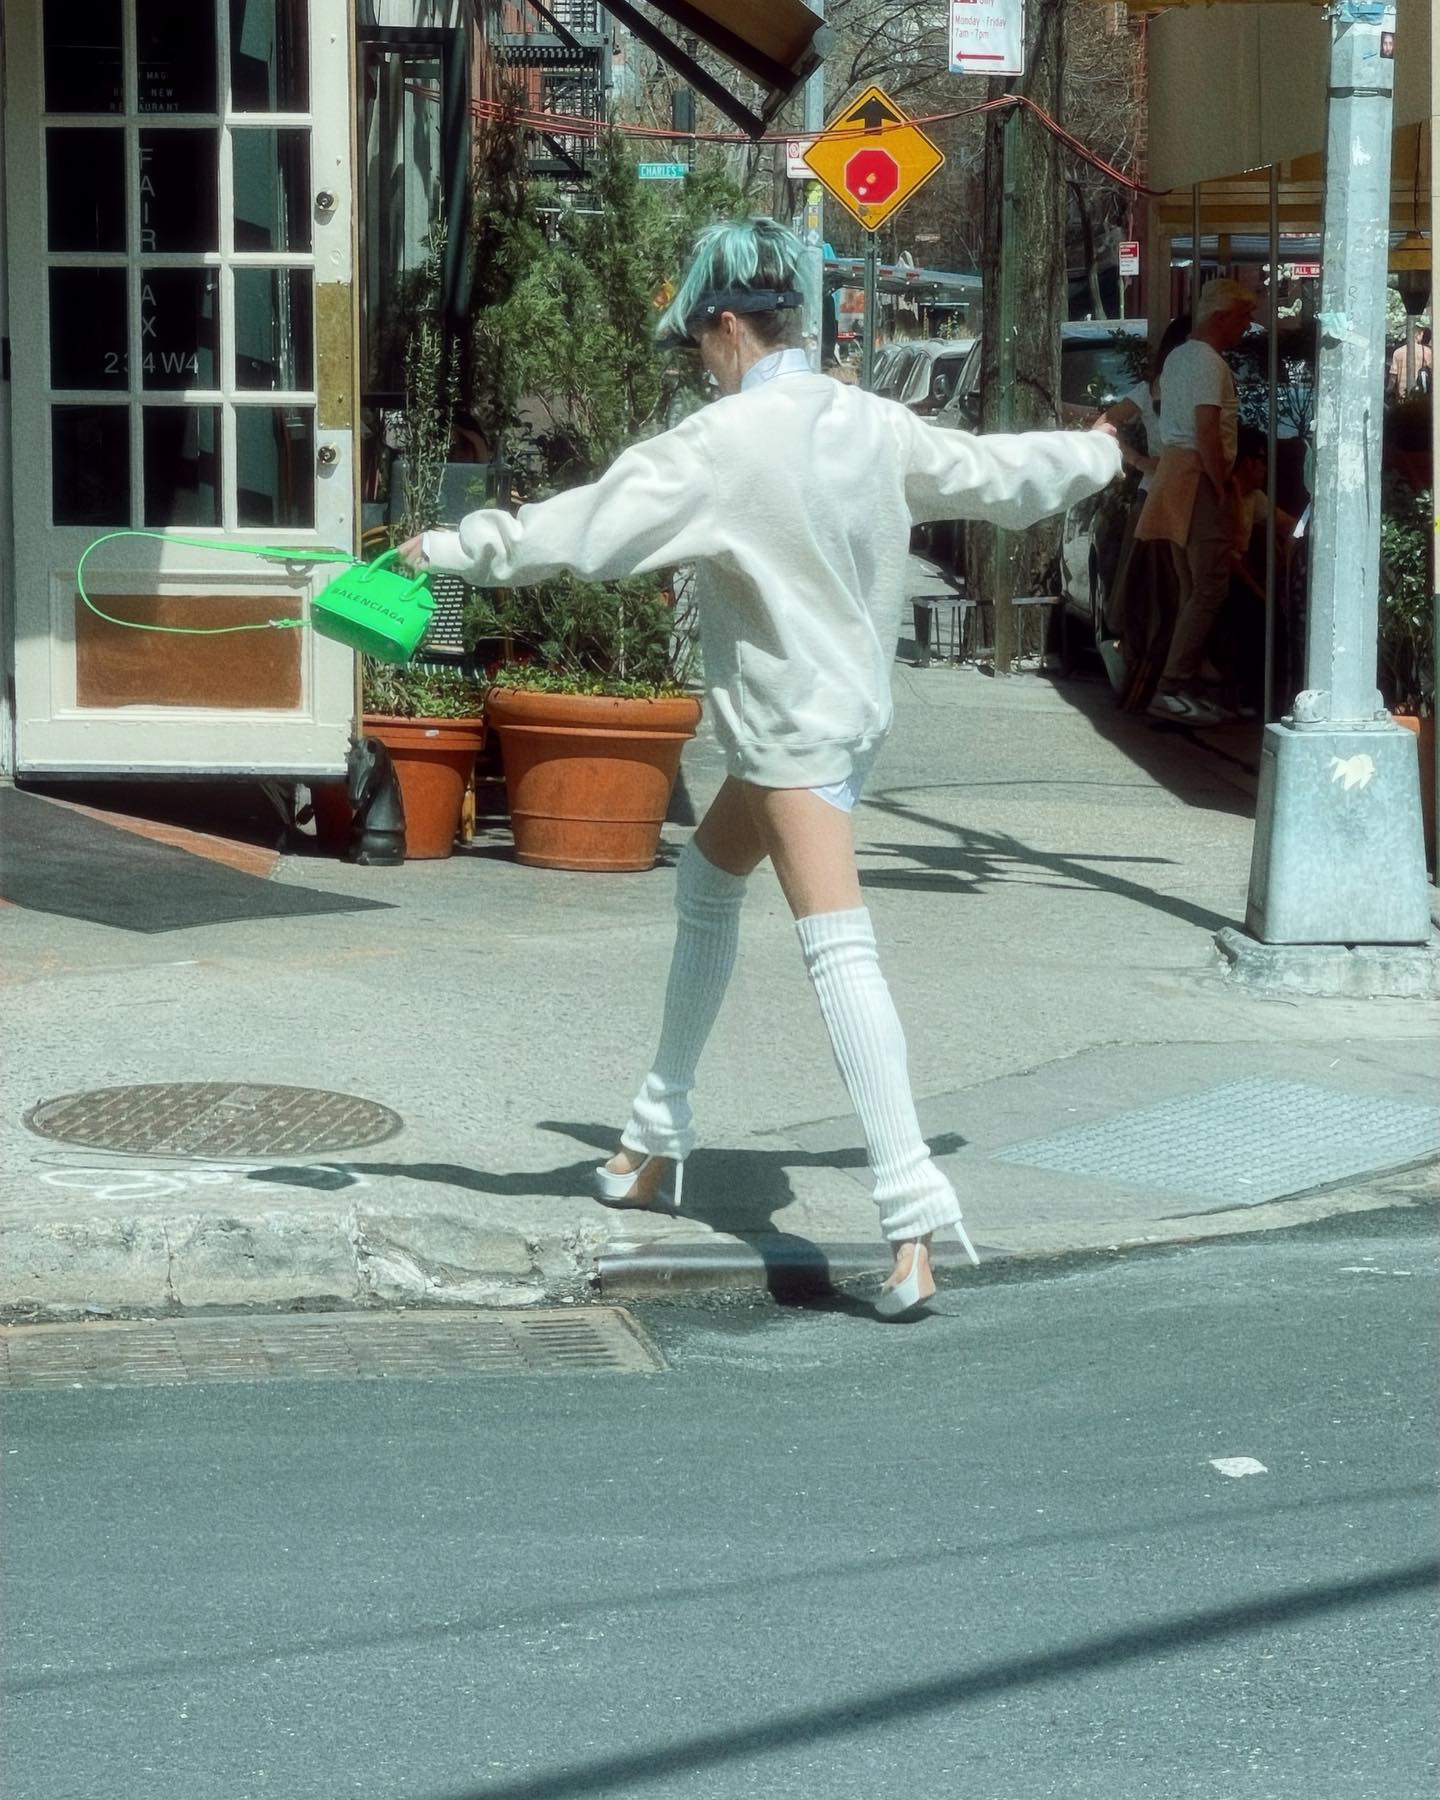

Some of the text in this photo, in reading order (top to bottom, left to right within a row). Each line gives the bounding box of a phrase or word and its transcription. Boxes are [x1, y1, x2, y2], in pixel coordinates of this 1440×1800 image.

[955, 15, 979, 27] Monday
[986, 16, 1007, 29] Friday
[955, 28, 969, 38] 7am
[975, 29, 990, 40] 7pm
[151, 88, 175, 97] NEW
[110, 102, 180, 112] REAURANT
[641, 166, 677, 177] CHARLES
[1295, 267, 1308, 275] ALL
[331, 587, 406, 626] BALENCIAGA
